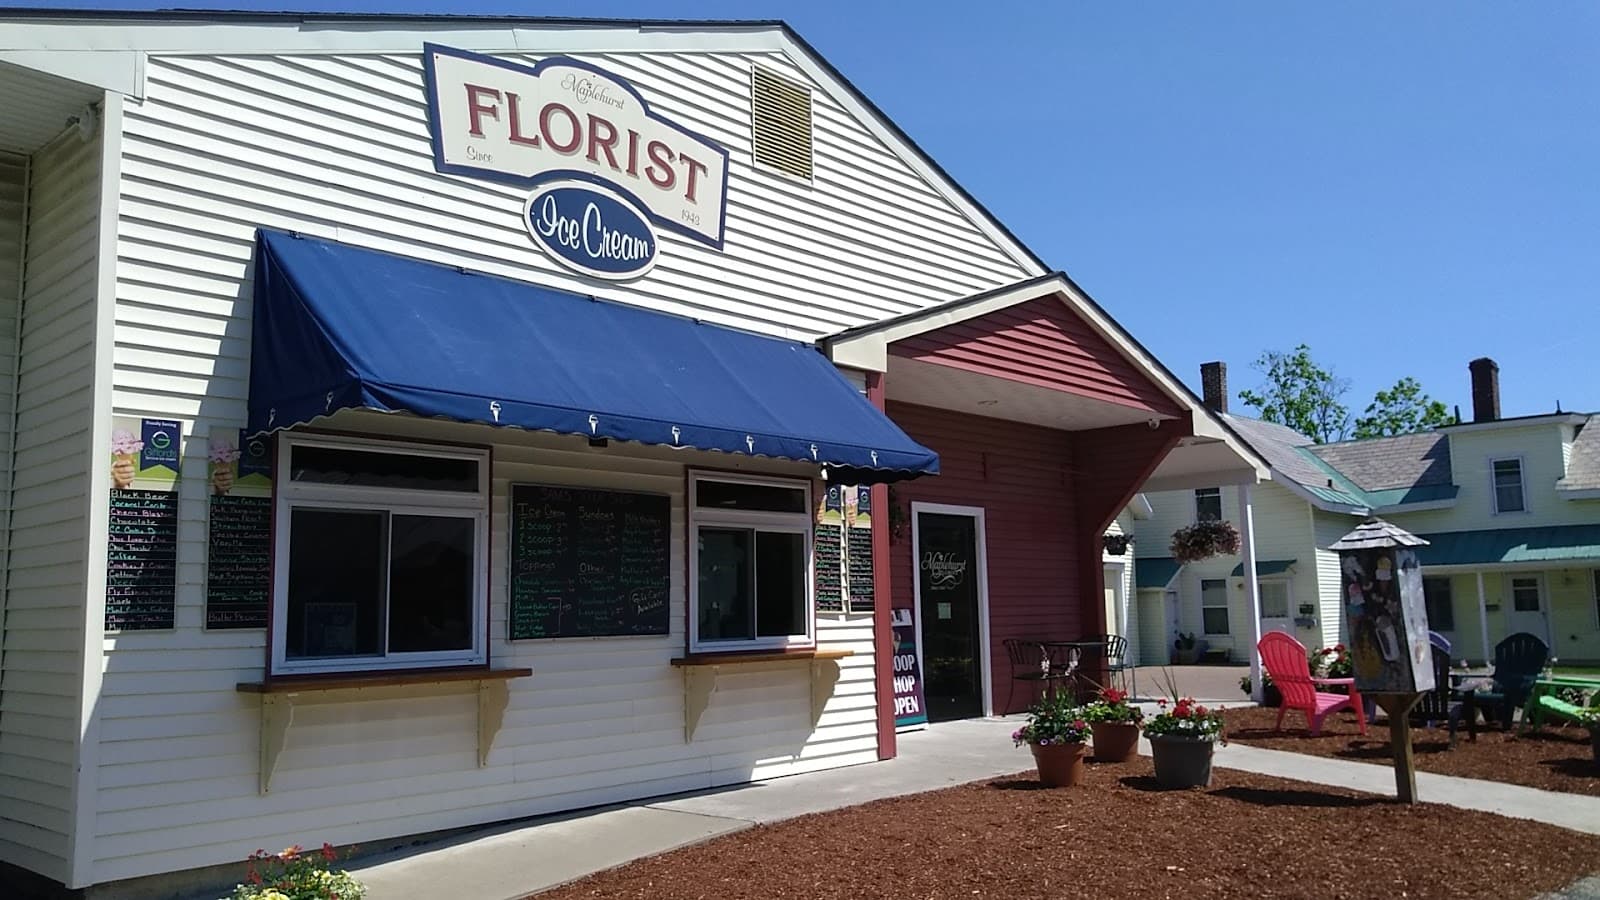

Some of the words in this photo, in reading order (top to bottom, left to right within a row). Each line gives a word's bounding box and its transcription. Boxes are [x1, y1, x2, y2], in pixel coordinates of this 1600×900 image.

[561, 73, 625, 111] Maplehurst
[464, 83, 708, 205] FLORIST
[466, 145, 494, 164] Since
[536, 195, 581, 249] Ice
[582, 202, 650, 261] Cream
[111, 489, 139, 499] Black
[894, 654, 915, 672] OOP
[894, 675, 915, 694] HOP
